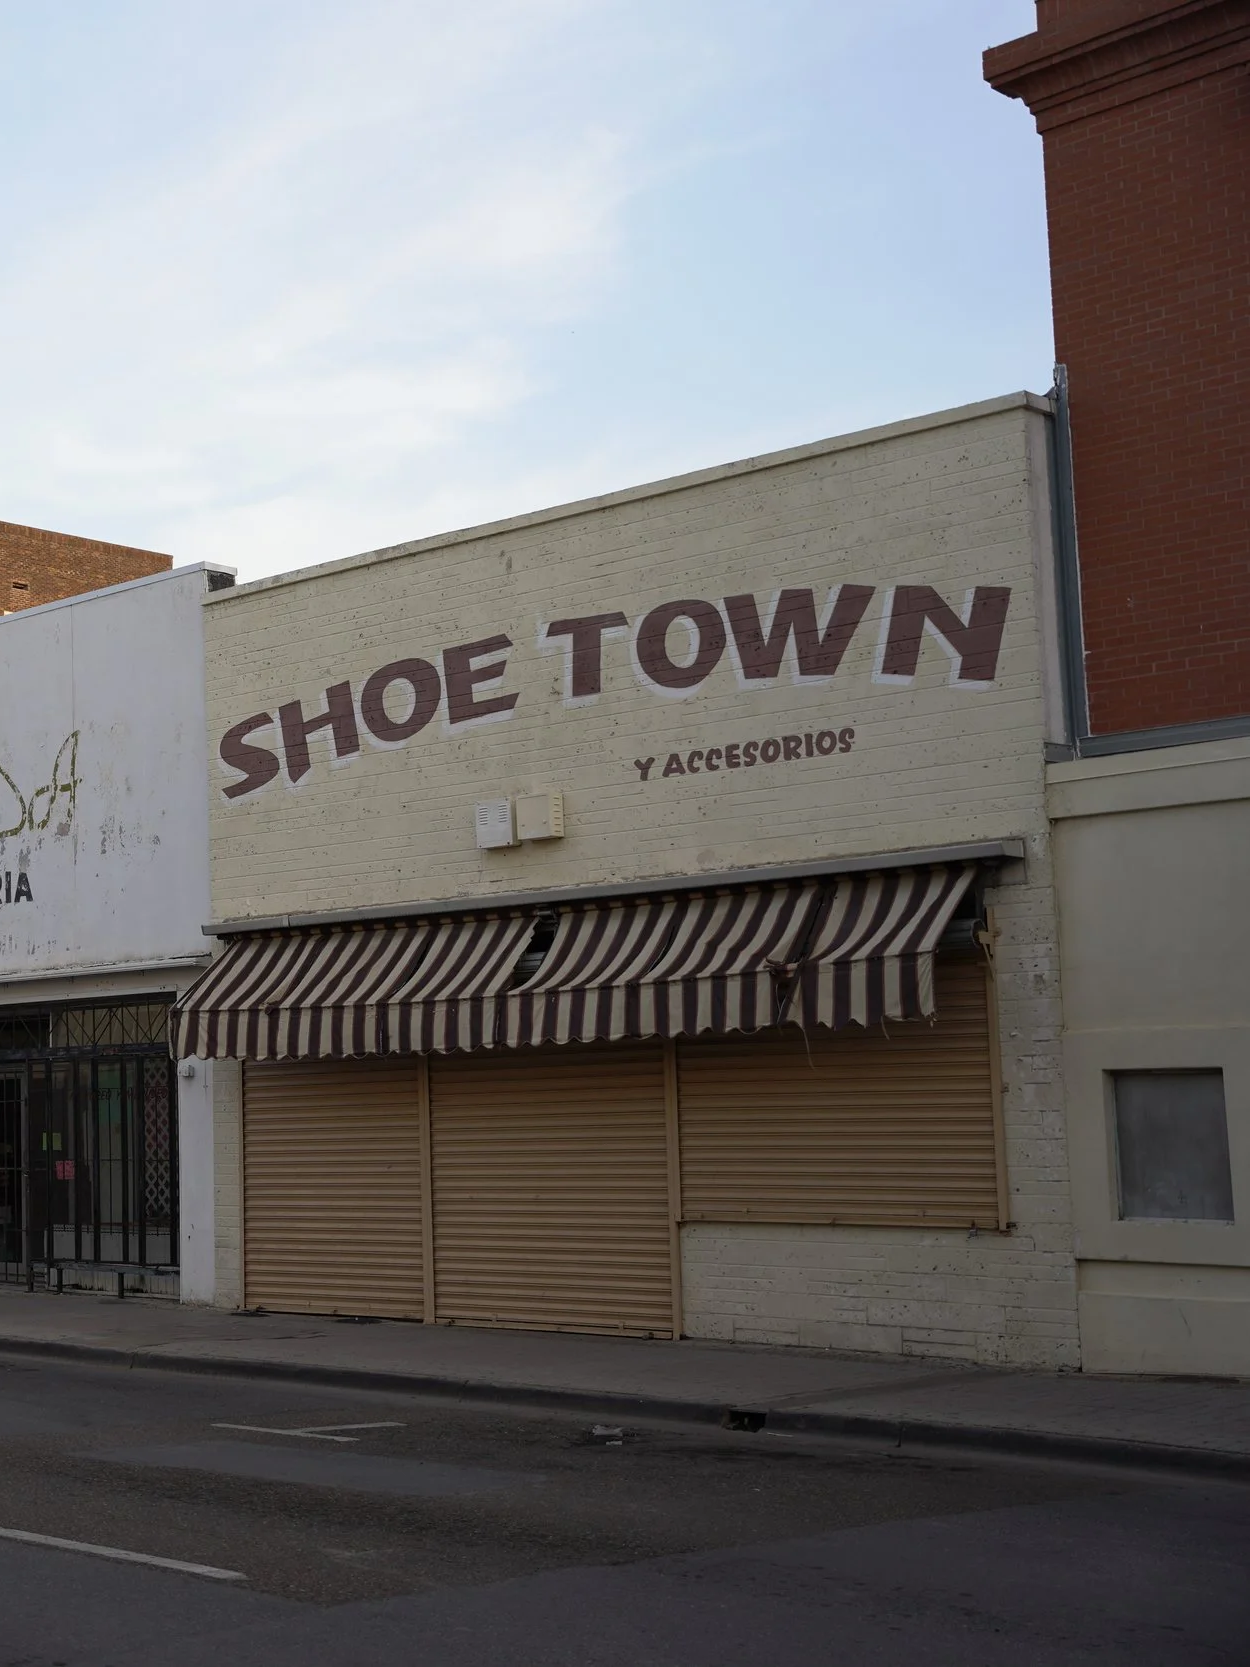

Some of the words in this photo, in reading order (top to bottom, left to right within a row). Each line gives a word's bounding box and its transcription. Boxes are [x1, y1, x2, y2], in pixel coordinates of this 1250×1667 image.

[218, 632, 520, 799] SHOE
[542, 584, 1012, 700] TOWN
[634, 756, 656, 782] Y
[661, 727, 856, 779] ACCESORIOS
